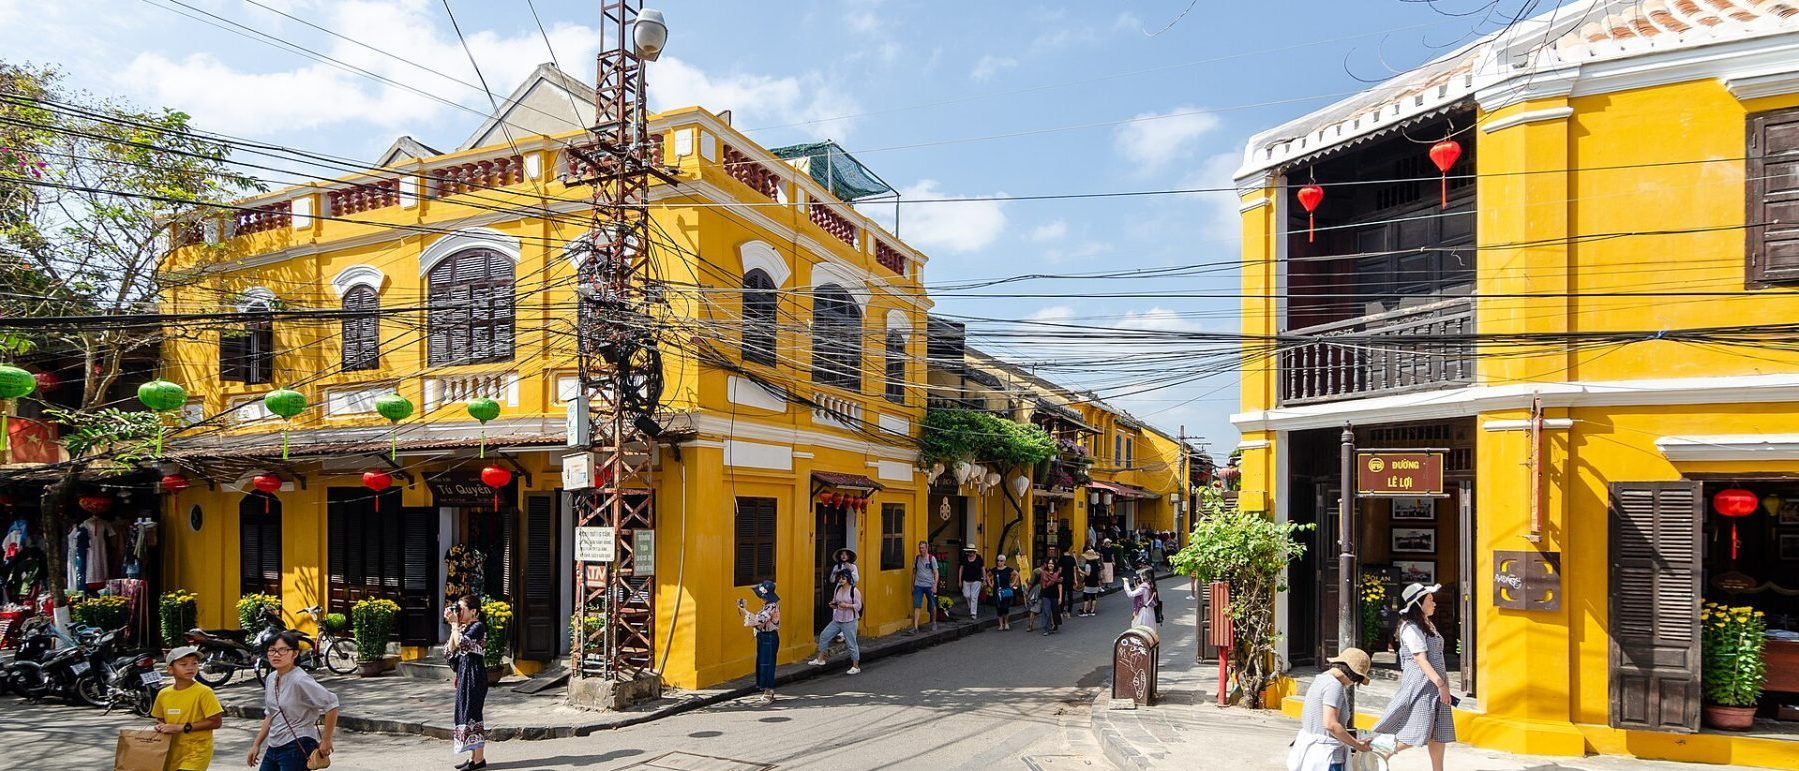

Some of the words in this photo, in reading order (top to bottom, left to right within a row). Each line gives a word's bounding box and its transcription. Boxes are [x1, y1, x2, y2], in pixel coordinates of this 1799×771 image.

[1391, 458, 1420, 469] ĐƯỜNG
[1387, 475, 1398, 488] LÊ
[1399, 476, 1413, 489] LỢI
[455, 484, 492, 496] Quyên
